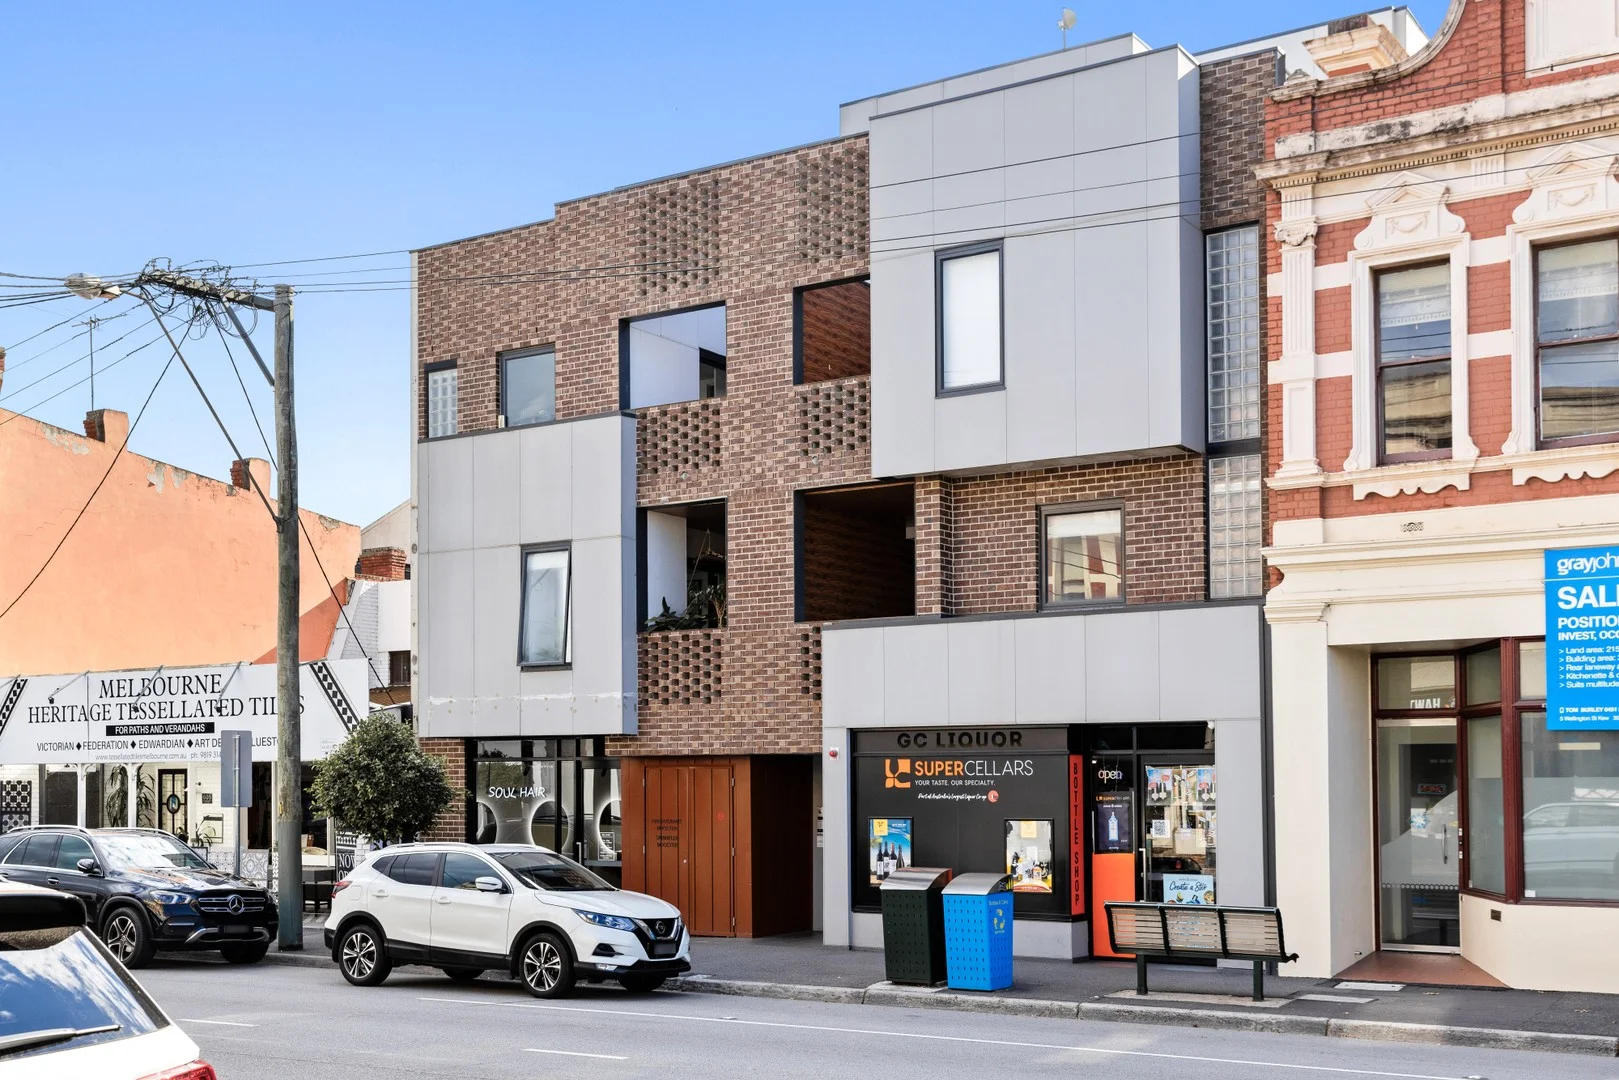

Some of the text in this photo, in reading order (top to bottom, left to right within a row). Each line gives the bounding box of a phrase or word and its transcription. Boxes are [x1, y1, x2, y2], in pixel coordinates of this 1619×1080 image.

[1558, 615, 1619, 629] POSITIO
[1558, 631, 1597, 641] INVEST,
[99, 674, 222, 698] MELBOURNE
[28, 695, 305, 723] HERITAGE TESSELLATED TILS
[115, 723, 206, 735] FOR PATHS AND VERANDAHS
[37, 742, 75, 751] VICTORIAN
[83, 740, 129, 750] FEDERATION
[139, 738, 185, 749] EDWARDIAN
[195, 738, 210, 748] ART
[897, 731, 1023, 748] GC LIQUOR
[915, 760, 1034, 776] SUPERCELLARS
[1098, 770, 1123, 784] open
[488, 786, 546, 798] SOUL HAIR
[1169, 881, 1189, 891] Create
